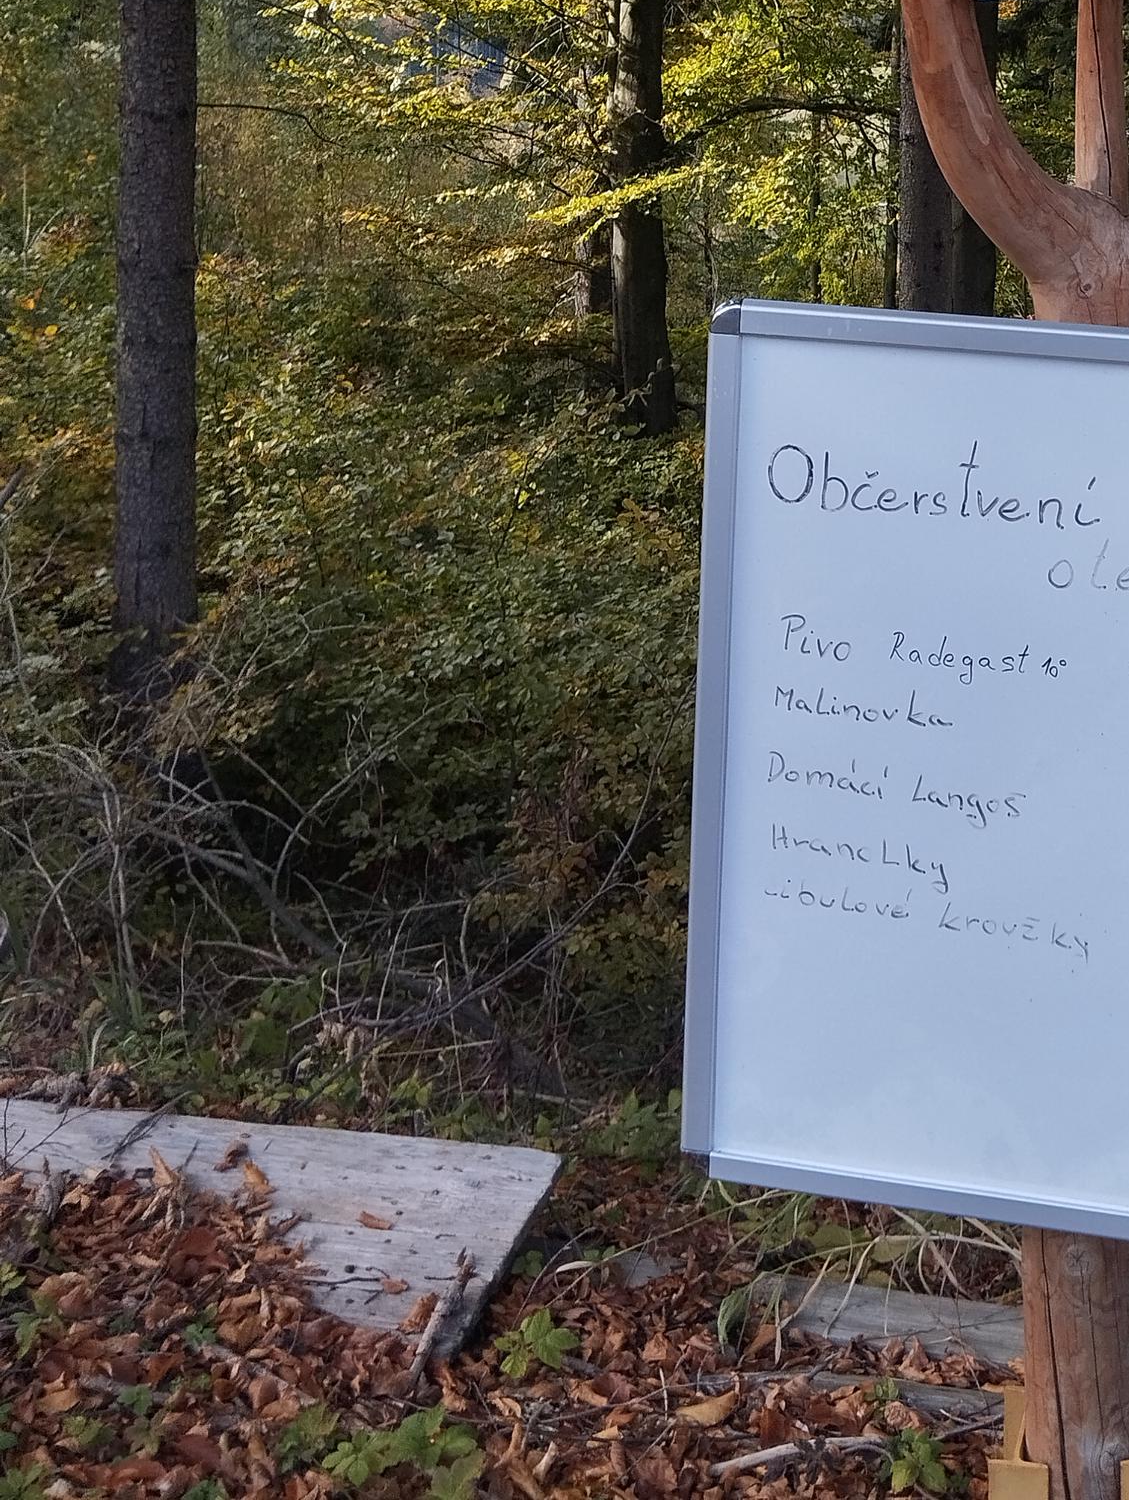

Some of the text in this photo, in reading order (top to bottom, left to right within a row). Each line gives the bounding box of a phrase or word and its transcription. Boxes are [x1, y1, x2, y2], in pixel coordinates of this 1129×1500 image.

[768, 440, 1101, 529] Občerstvení
[780, 615, 851, 662] Pivo
[889, 631, 1030, 685] Radegast
[774, 685, 953, 728] Malinovka
[767, 750, 889, 801] Domácí
